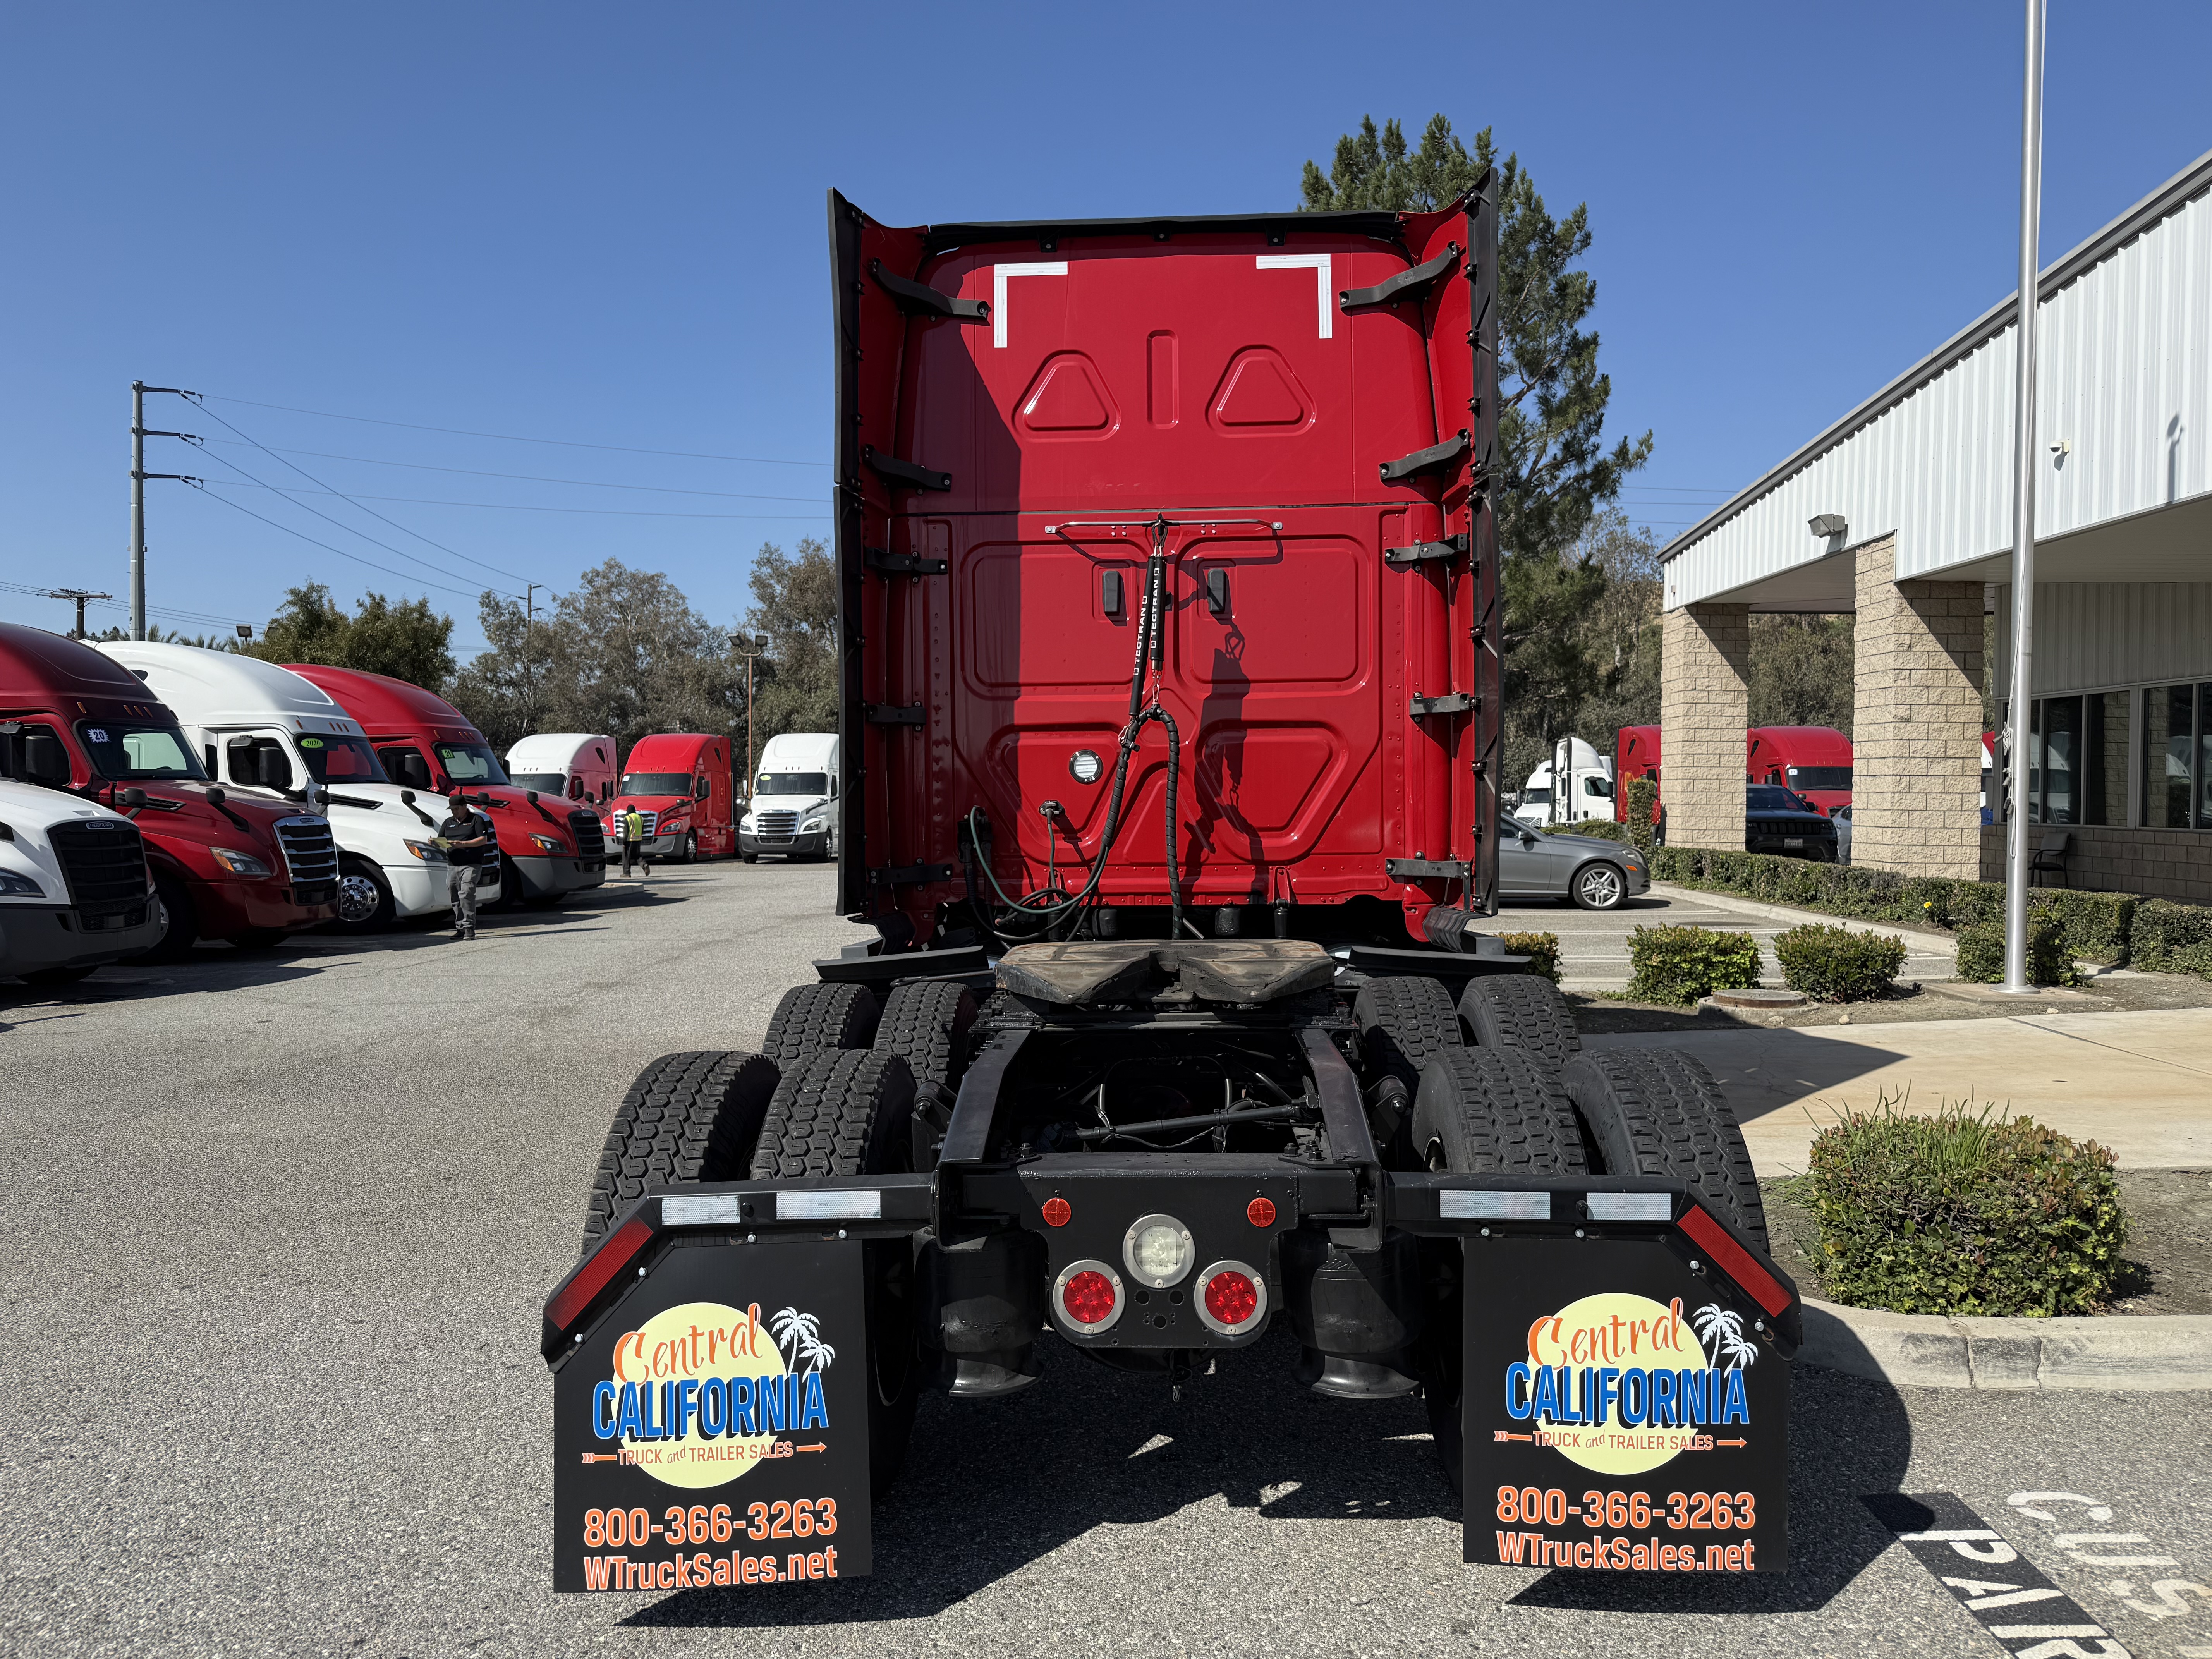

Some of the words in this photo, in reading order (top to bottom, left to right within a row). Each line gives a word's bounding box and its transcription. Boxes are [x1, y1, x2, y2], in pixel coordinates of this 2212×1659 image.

[1150, 580, 1159, 637] TECTRAN
[1135, 608, 1146, 664] TECTRAN
[93, 731, 104, 740] 20
[613, 1303, 762, 1386] Central
[1528, 1297, 1685, 1370] Central
[593, 1371, 829, 1439] CALIFORNIA
[1506, 1362, 1749, 1424] CALIFORNIA
[618, 1449, 662, 1465] TRUCK
[667, 1443, 686, 1463] and
[689, 1445, 745, 1463] TRAILER
[749, 1442, 794, 1460] SALES
[1533, 1431, 1581, 1448] TRUCK
[1586, 1429, 1606, 1449] and
[1608, 1434, 1665, 1450] TRAILER
[1670, 1435, 1714, 1451] SALES
[584, 1498, 837, 1547] 800-366-3263
[1497, 1486, 1756, 1530] 800-366-3263
[584, 1545, 838, 1590] WTruckSales.net
[1497, 1531, 1755, 1571] WTruckSales.net
